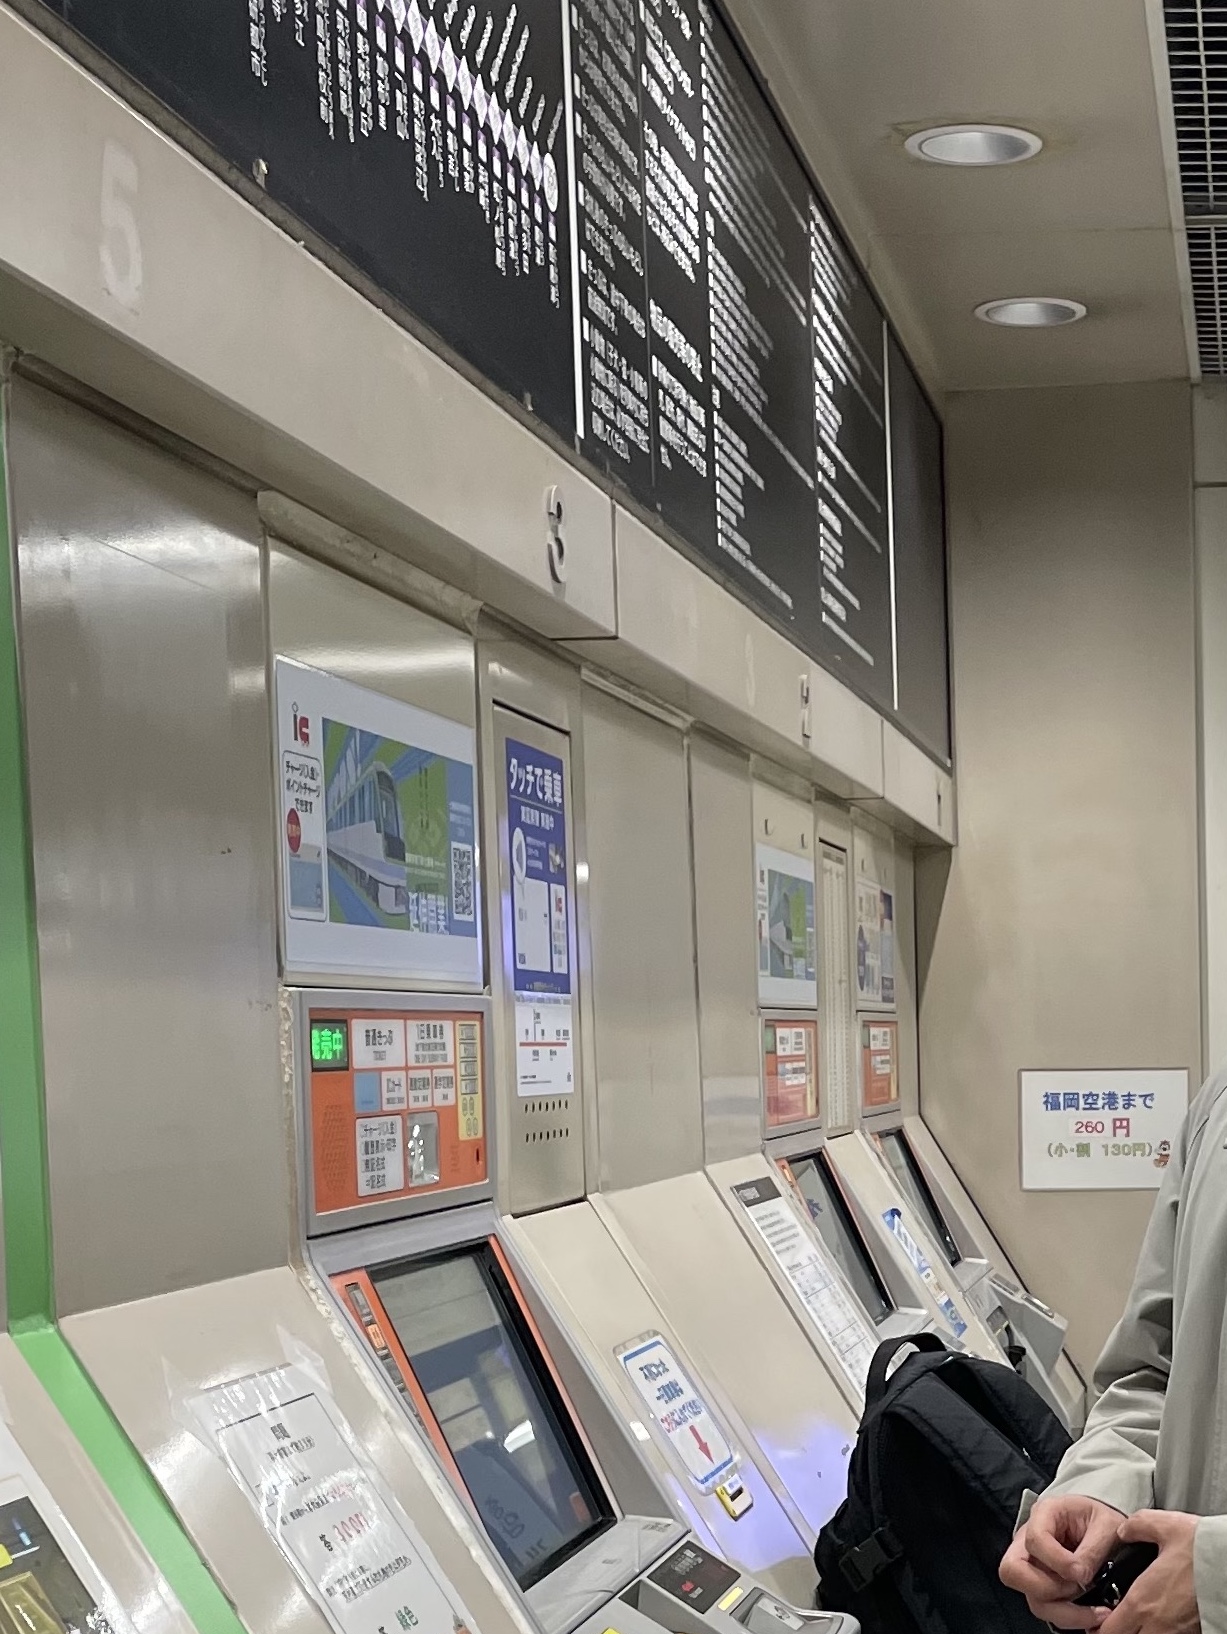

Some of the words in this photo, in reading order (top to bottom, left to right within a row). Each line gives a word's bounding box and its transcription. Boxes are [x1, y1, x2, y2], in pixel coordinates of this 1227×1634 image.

[1042, 1090, 1155, 1112] 福岡空港まで
[1074, 1120, 1105, 1134] 260
[1112, 1117, 1130, 1138] 円
